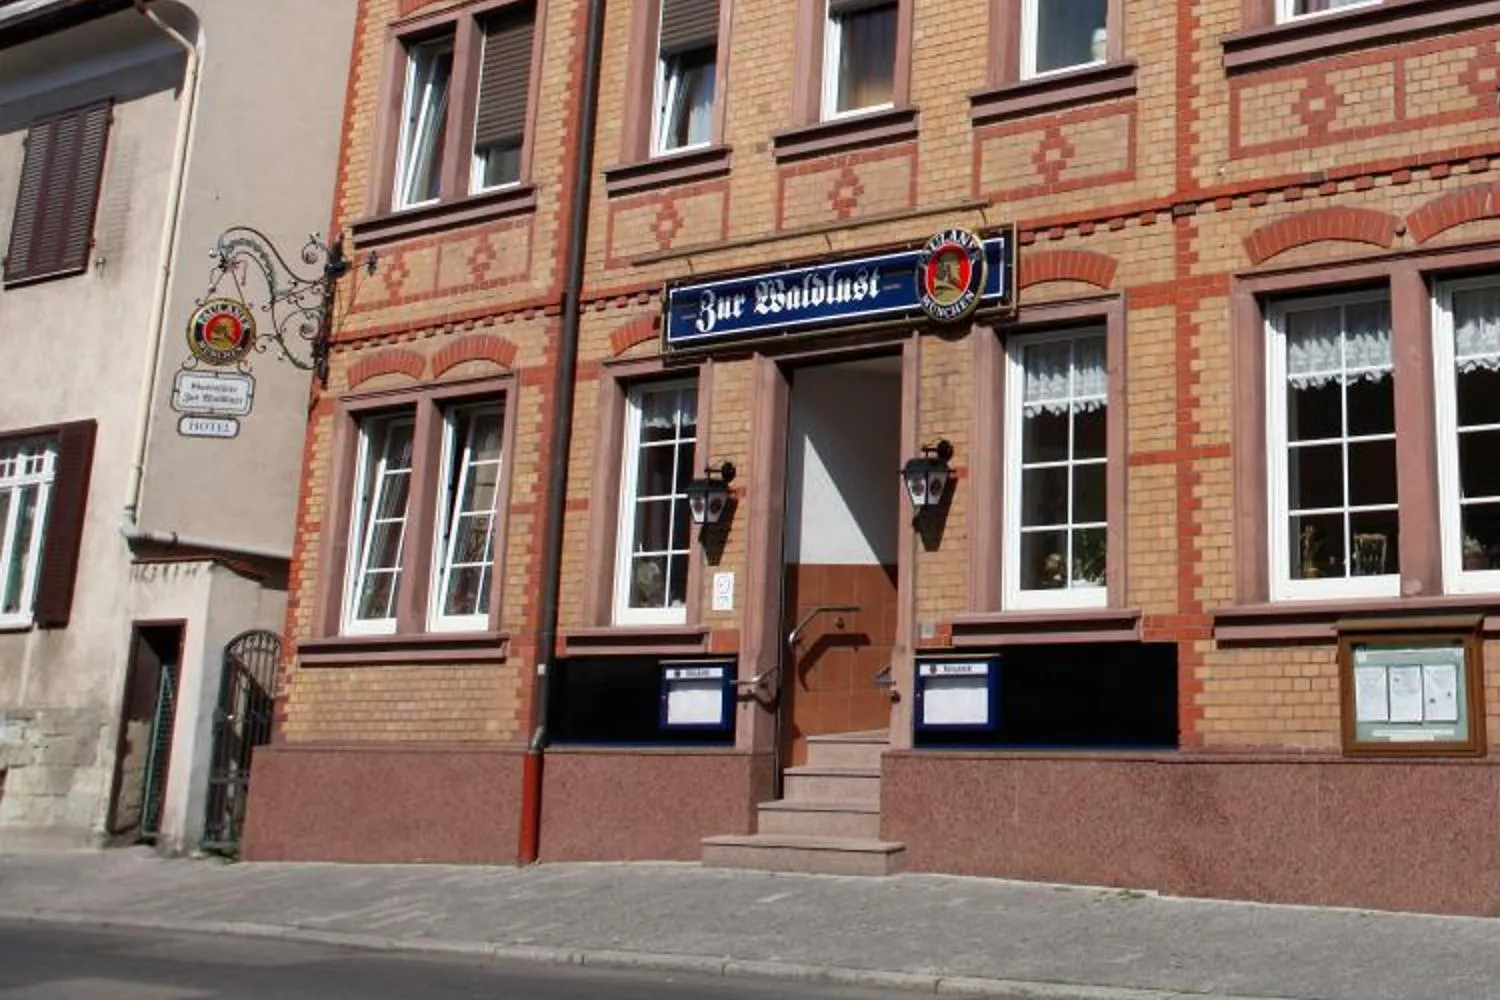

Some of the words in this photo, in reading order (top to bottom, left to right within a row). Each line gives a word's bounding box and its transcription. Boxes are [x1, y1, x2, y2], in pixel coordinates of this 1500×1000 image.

[695, 289, 745, 333] Zur
[754, 265, 881, 315] Waldlust
[189, 422, 230, 433] HOTEL
